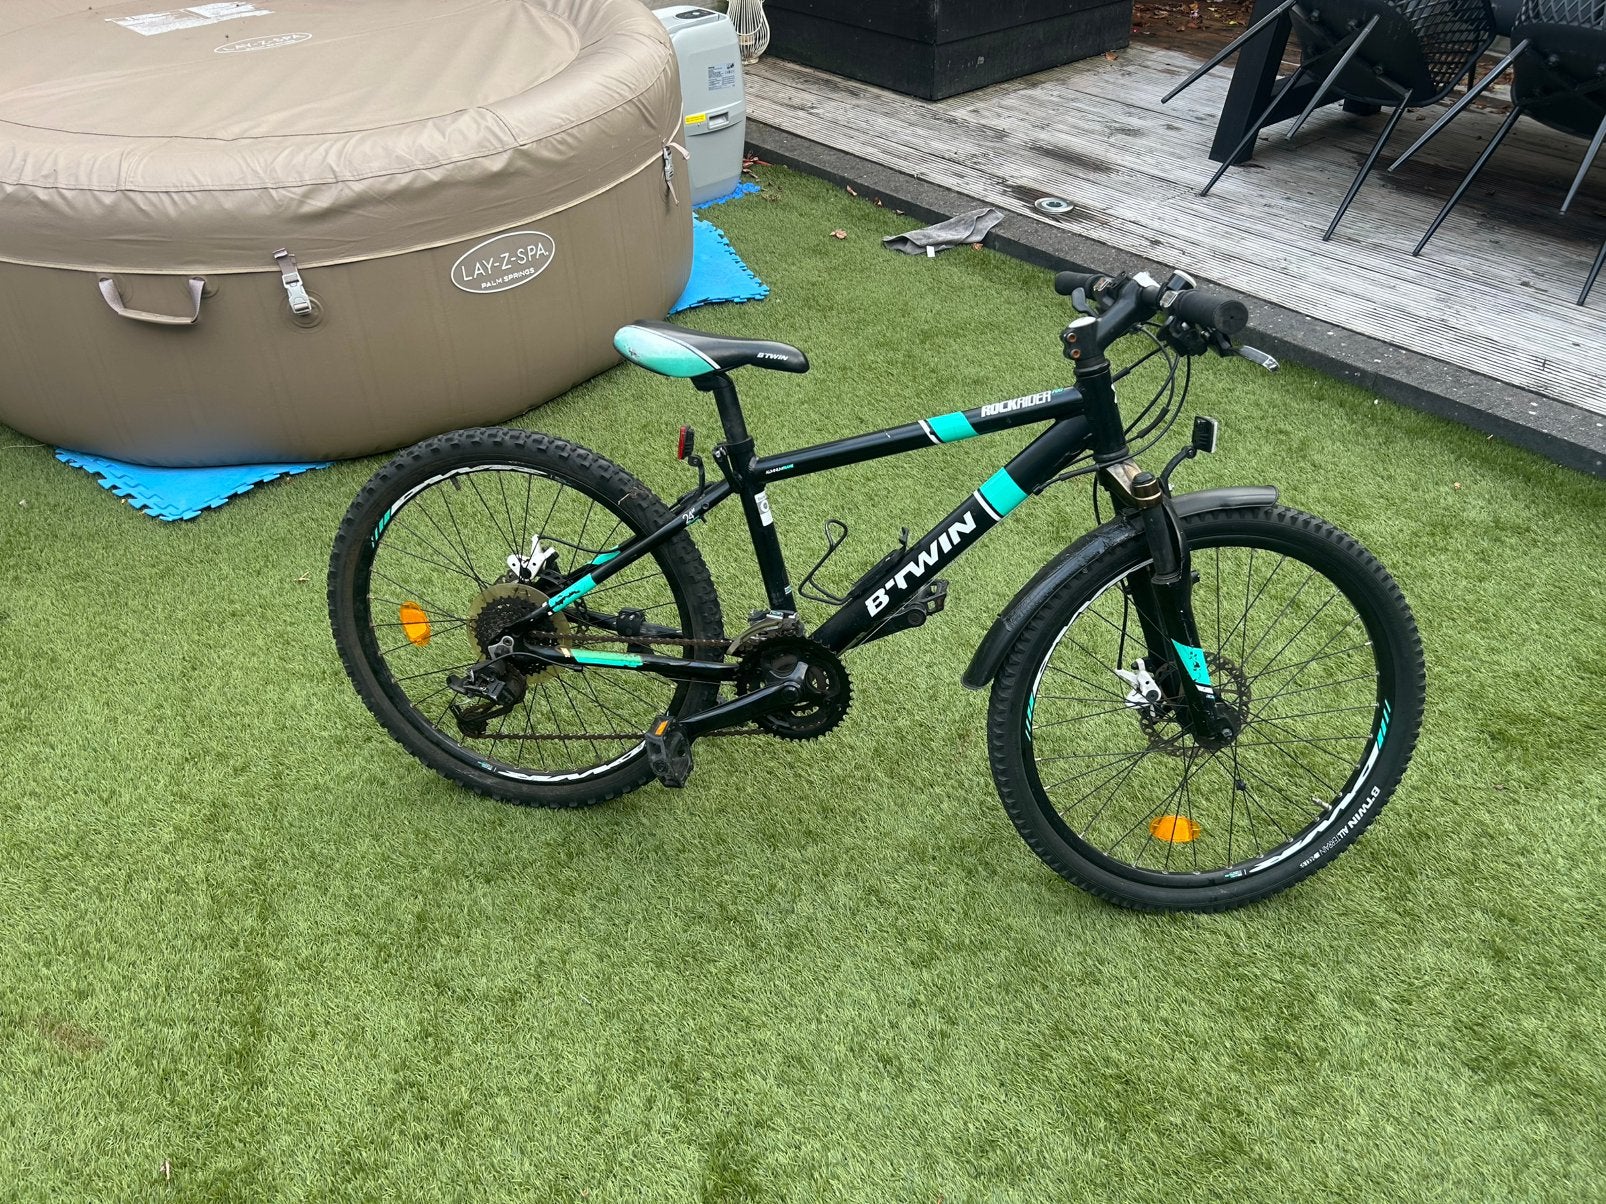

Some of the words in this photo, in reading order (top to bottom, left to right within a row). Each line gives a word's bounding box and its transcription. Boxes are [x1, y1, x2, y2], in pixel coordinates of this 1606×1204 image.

[481, 278, 502, 289] PALM
[503, 267, 535, 282] SPRINGS
[981, 390, 1052, 418] ROCKRIDER
